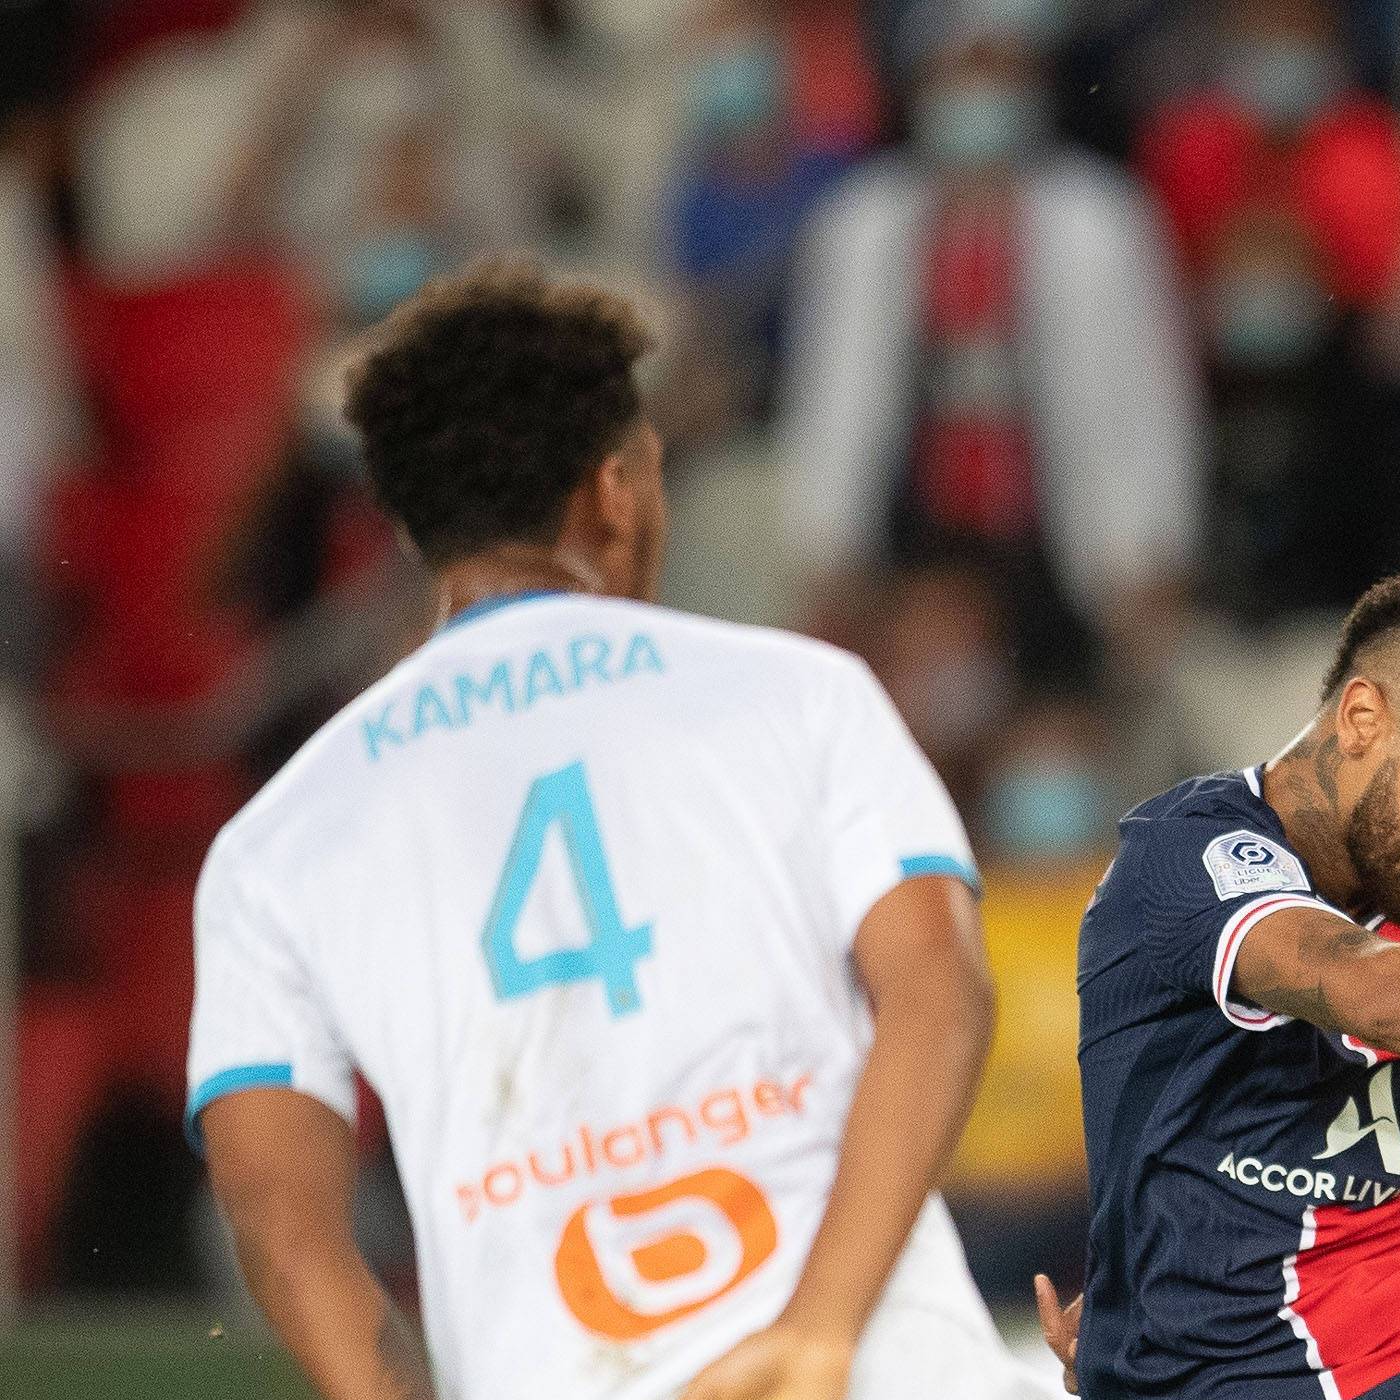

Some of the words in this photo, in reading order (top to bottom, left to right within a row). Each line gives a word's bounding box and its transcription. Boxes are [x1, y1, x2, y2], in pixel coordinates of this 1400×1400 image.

[361, 632, 666, 761] KAMARA
[479, 758, 654, 1020] 4
[1217, 1152, 1337, 1201] ACCOR
